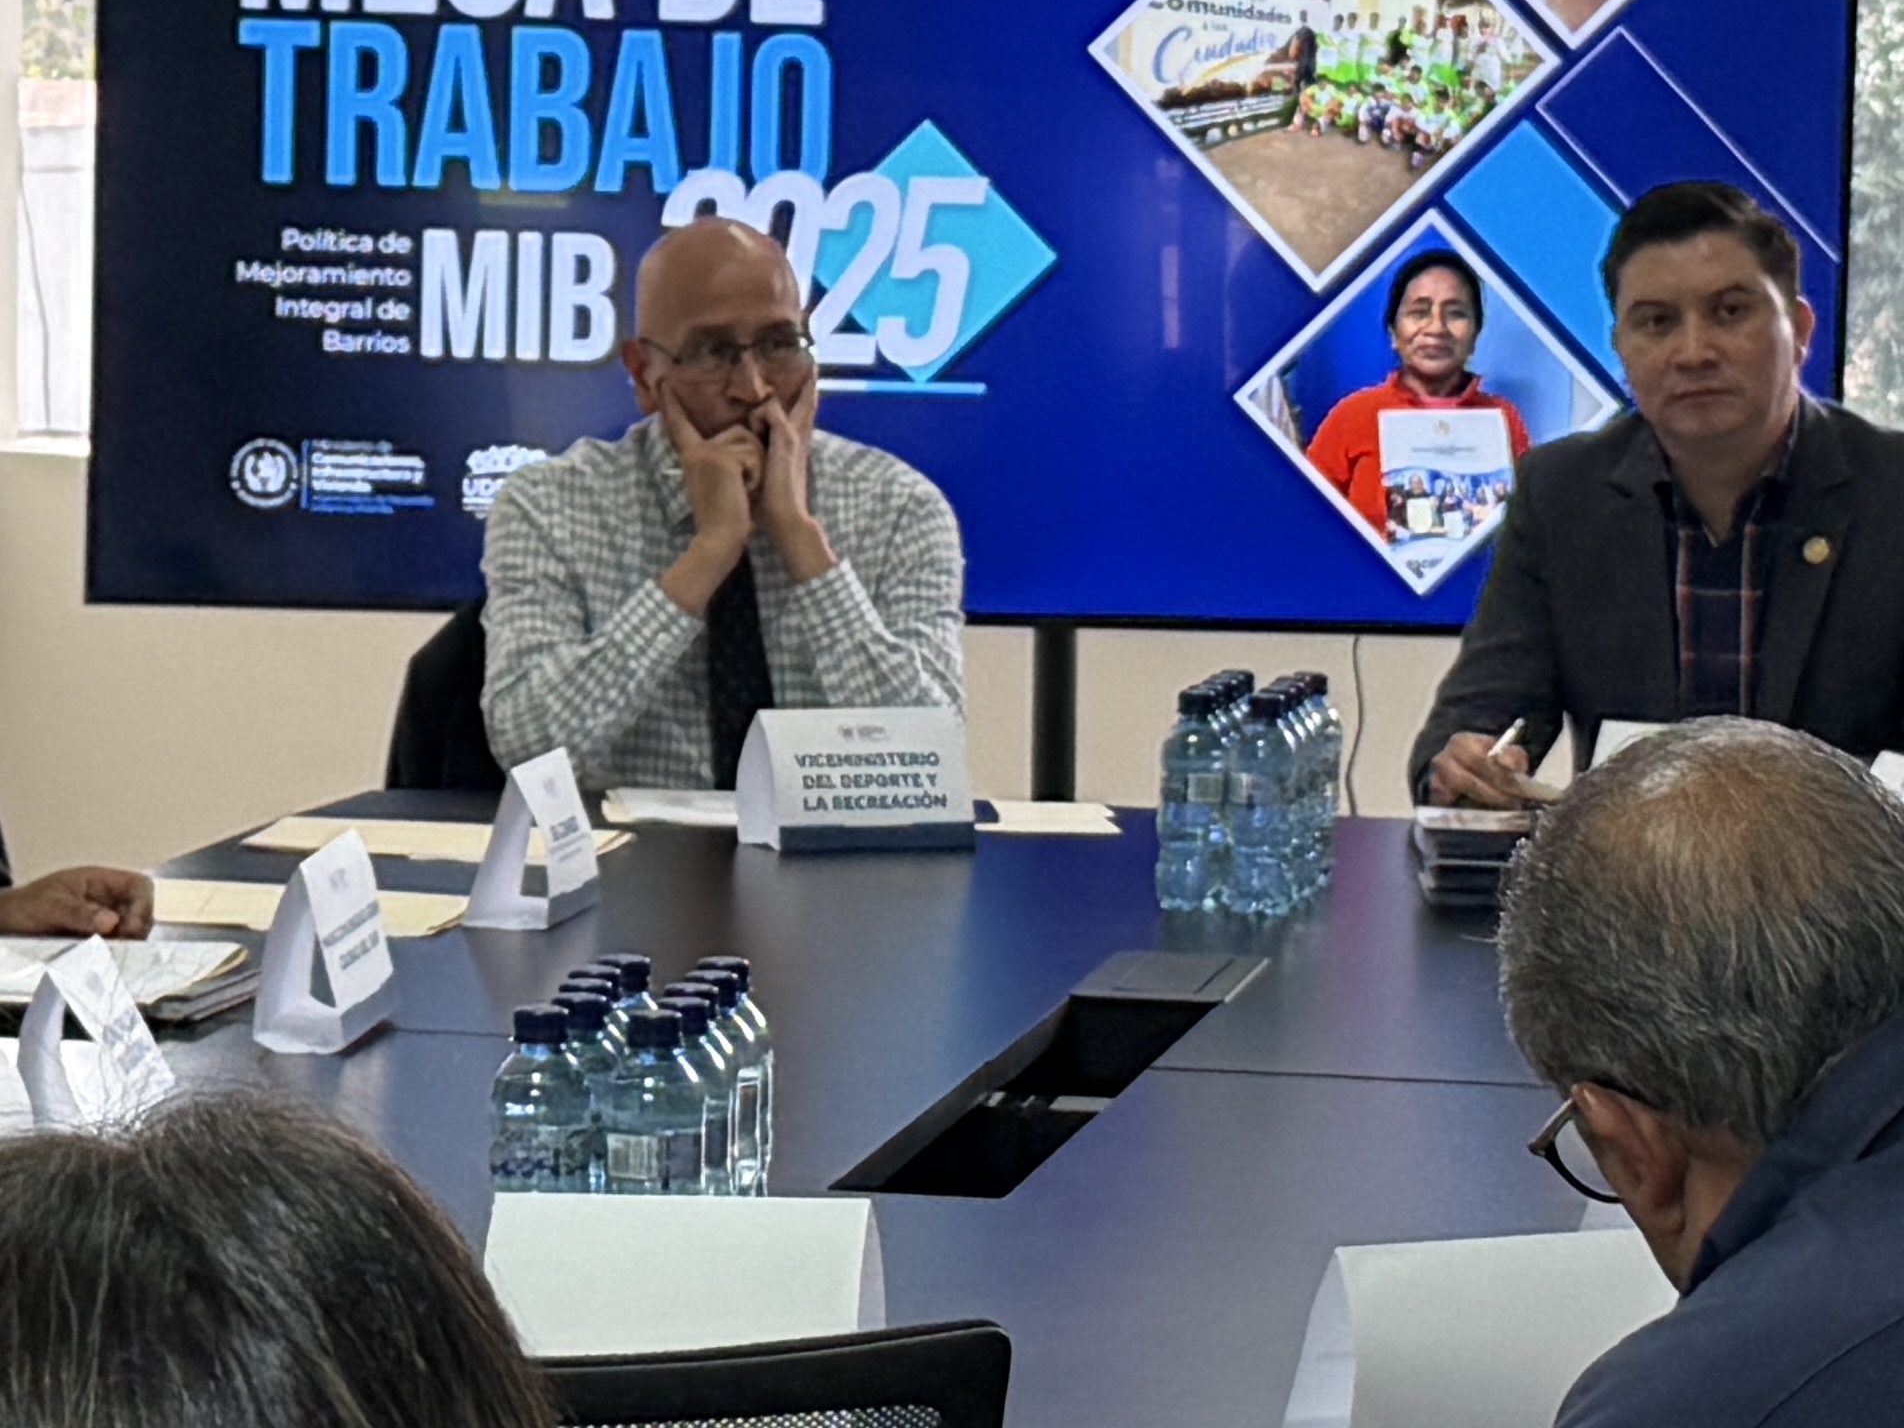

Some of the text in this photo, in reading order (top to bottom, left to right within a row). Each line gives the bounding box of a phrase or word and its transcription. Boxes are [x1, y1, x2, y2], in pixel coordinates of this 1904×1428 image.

[238, 18, 834, 194] TRABAJO
[281, 227, 413, 254] Política de
[235, 260, 413, 289] Mejoramiento
[419, 228, 617, 362] MIB
[275, 296, 412, 323] Integral de
[322, 329, 412, 354] Barrios
[794, 751, 941, 769] VICEMINISTERIO
[802, 773, 938, 790] DEL DEPORTE Y
[802, 790, 948, 812] LA RECREACIÓN
